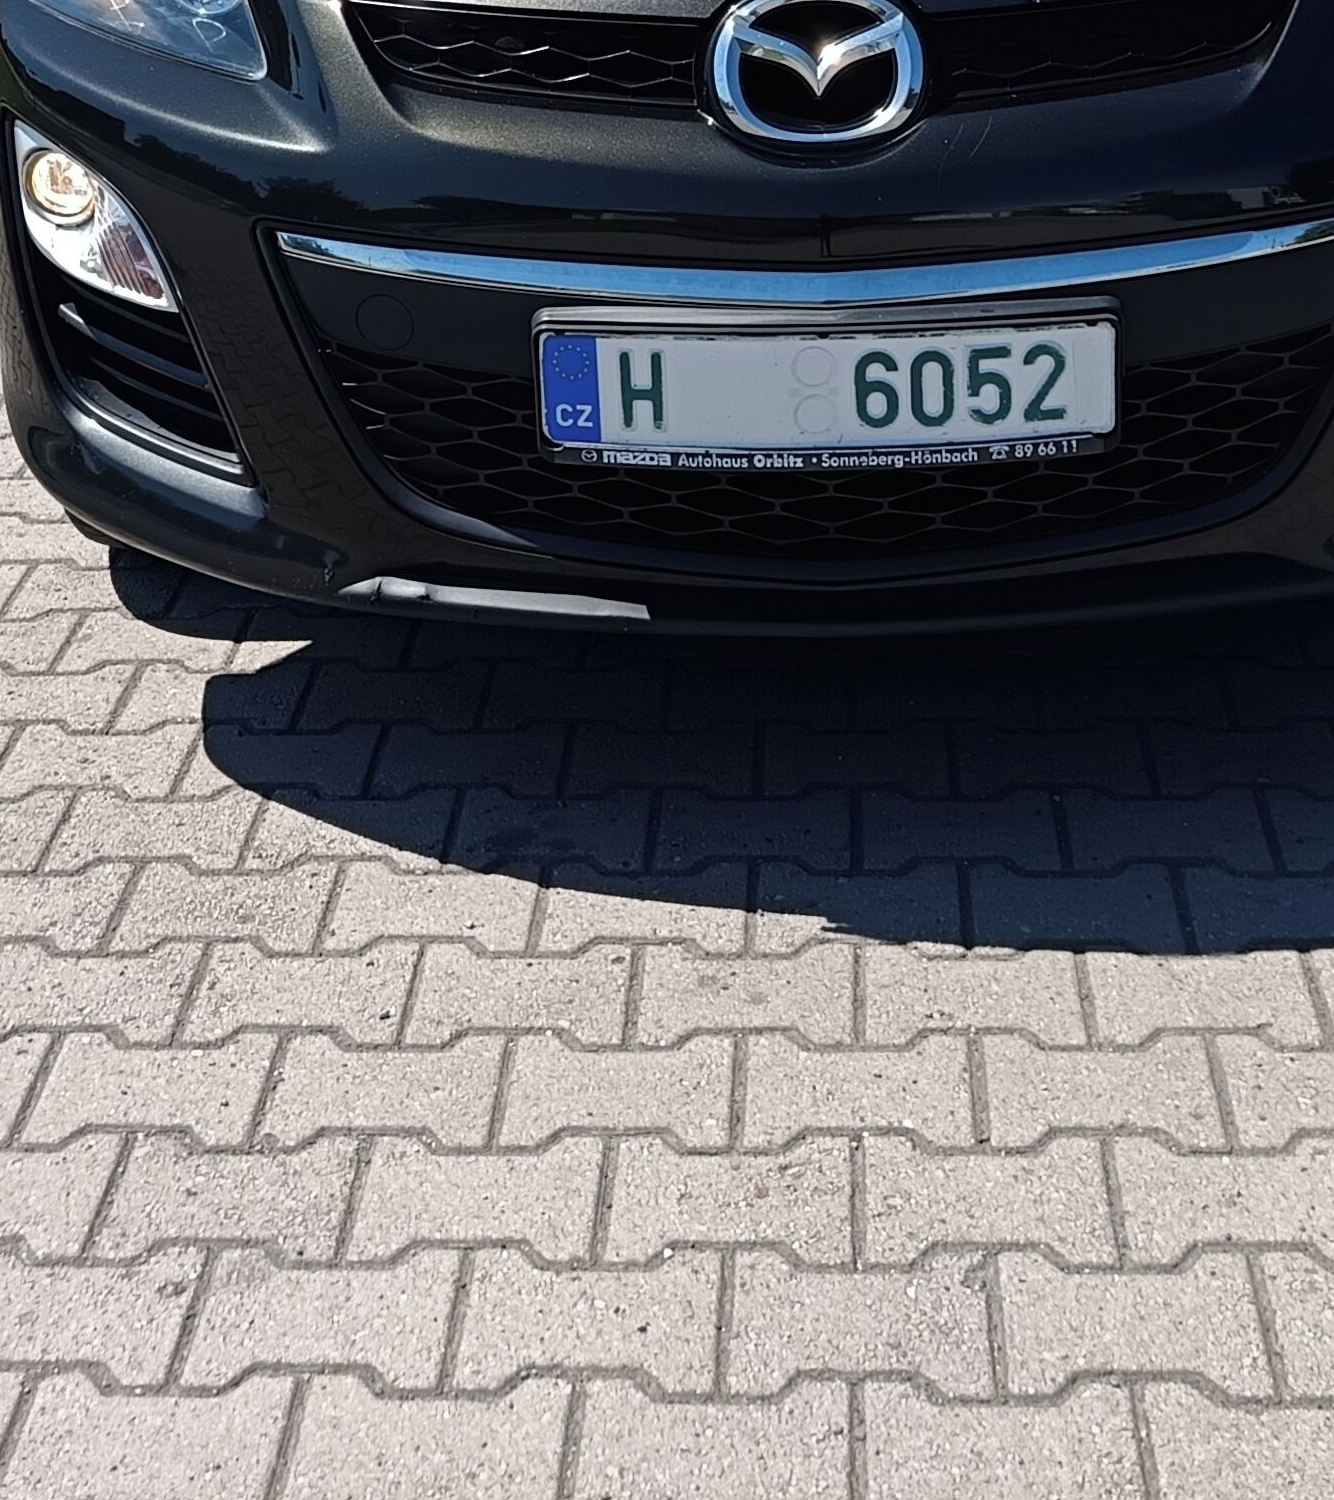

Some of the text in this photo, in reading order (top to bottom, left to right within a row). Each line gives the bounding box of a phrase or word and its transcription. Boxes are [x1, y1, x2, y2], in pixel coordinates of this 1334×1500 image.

[618, 344, 1067, 430] H 6052
[555, 404, 594, 428] CZ
[678, 452, 749, 468] Autohaus
[753, 453, 804, 468] Orbitz
[1014, 443, 1034, 458] 89
[1037, 441, 1057, 456] 66
[1061, 439, 1078, 454] 11
